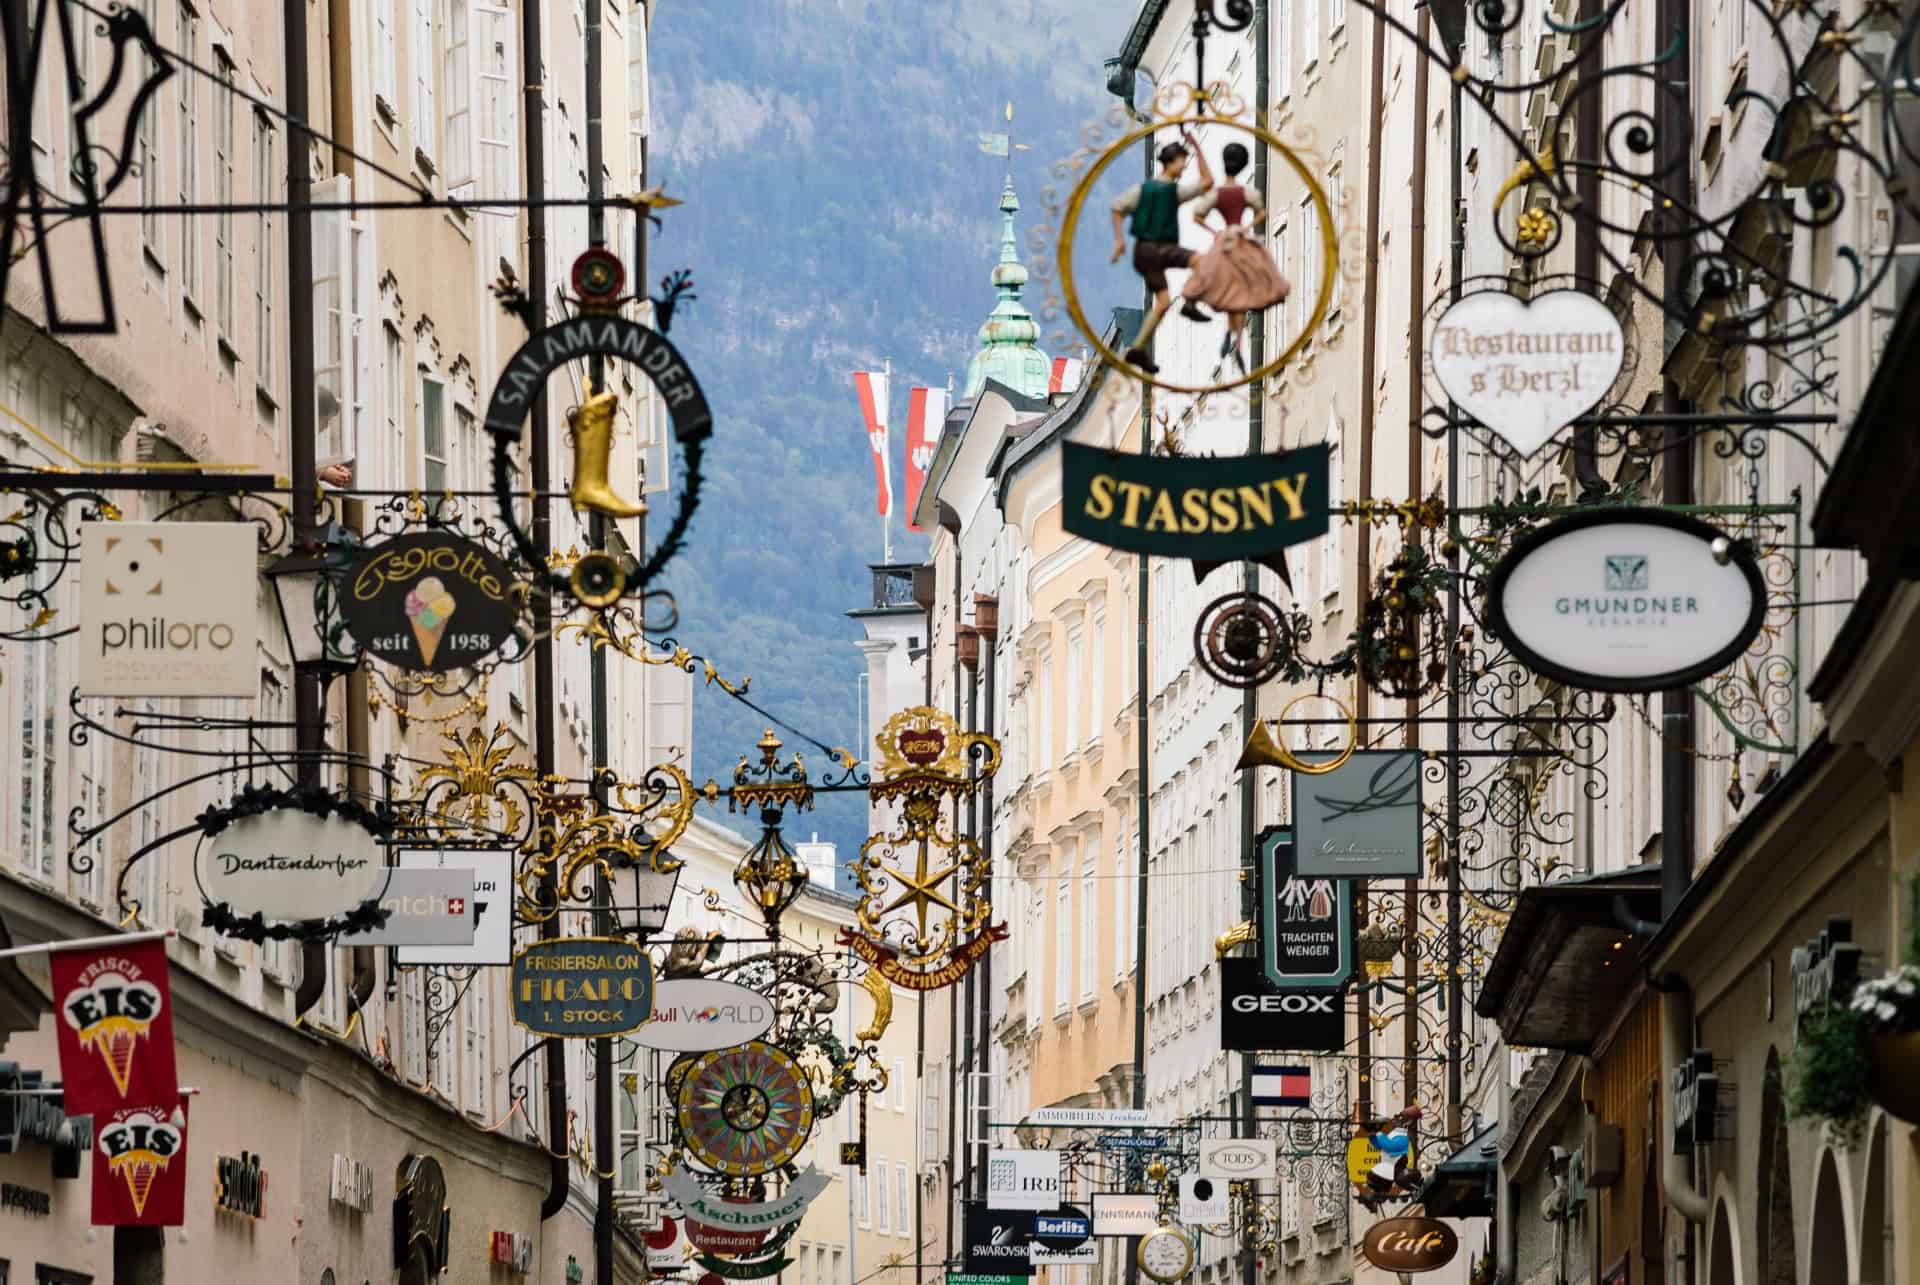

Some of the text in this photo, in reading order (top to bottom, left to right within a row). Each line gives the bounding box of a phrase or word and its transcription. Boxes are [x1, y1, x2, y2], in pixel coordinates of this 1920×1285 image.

[1437, 326, 1616, 359] Restaurant
[500, 322, 694, 406] SALAMANDER
[1084, 472, 1309, 534] STASSNY
[1555, 597, 1699, 614] GMUNDNER
[102, 617, 233, 656] philoro
[373, 634, 409, 650] seit
[450, 634, 490, 650] 1958
[217, 853, 368, 877] Dantendorfer
[379, 895, 446, 917] atch
[1281, 932, 1334, 943] TRACHTEN
[1286, 945, 1330, 956] WENGER
[525, 955, 639, 970] FRISIERSALON
[77, 958, 143, 986] FRISCH
[881, 959, 968, 989] Sternbräu
[520, 976, 645, 1002] FIGARO
[67, 987, 156, 1031] EIS
[1231, 995, 1335, 1013] GEOX
[563, 1010, 625, 1022] STOCK
[1037, 1111, 1105, 1121] IMMOBILIEN
[102, 1126, 177, 1158] EIS
[1022, 1177, 1057, 1191] IRB
[691, 1197, 804, 1224] Aschauer
[1038, 1220, 1085, 1233] Berlitz
[696, 1235, 757, 1247] Restaurant
[972, 1245, 1030, 1257] SWAROVSKI
[948, 1274, 1010, 1283] UNITED COLORS
